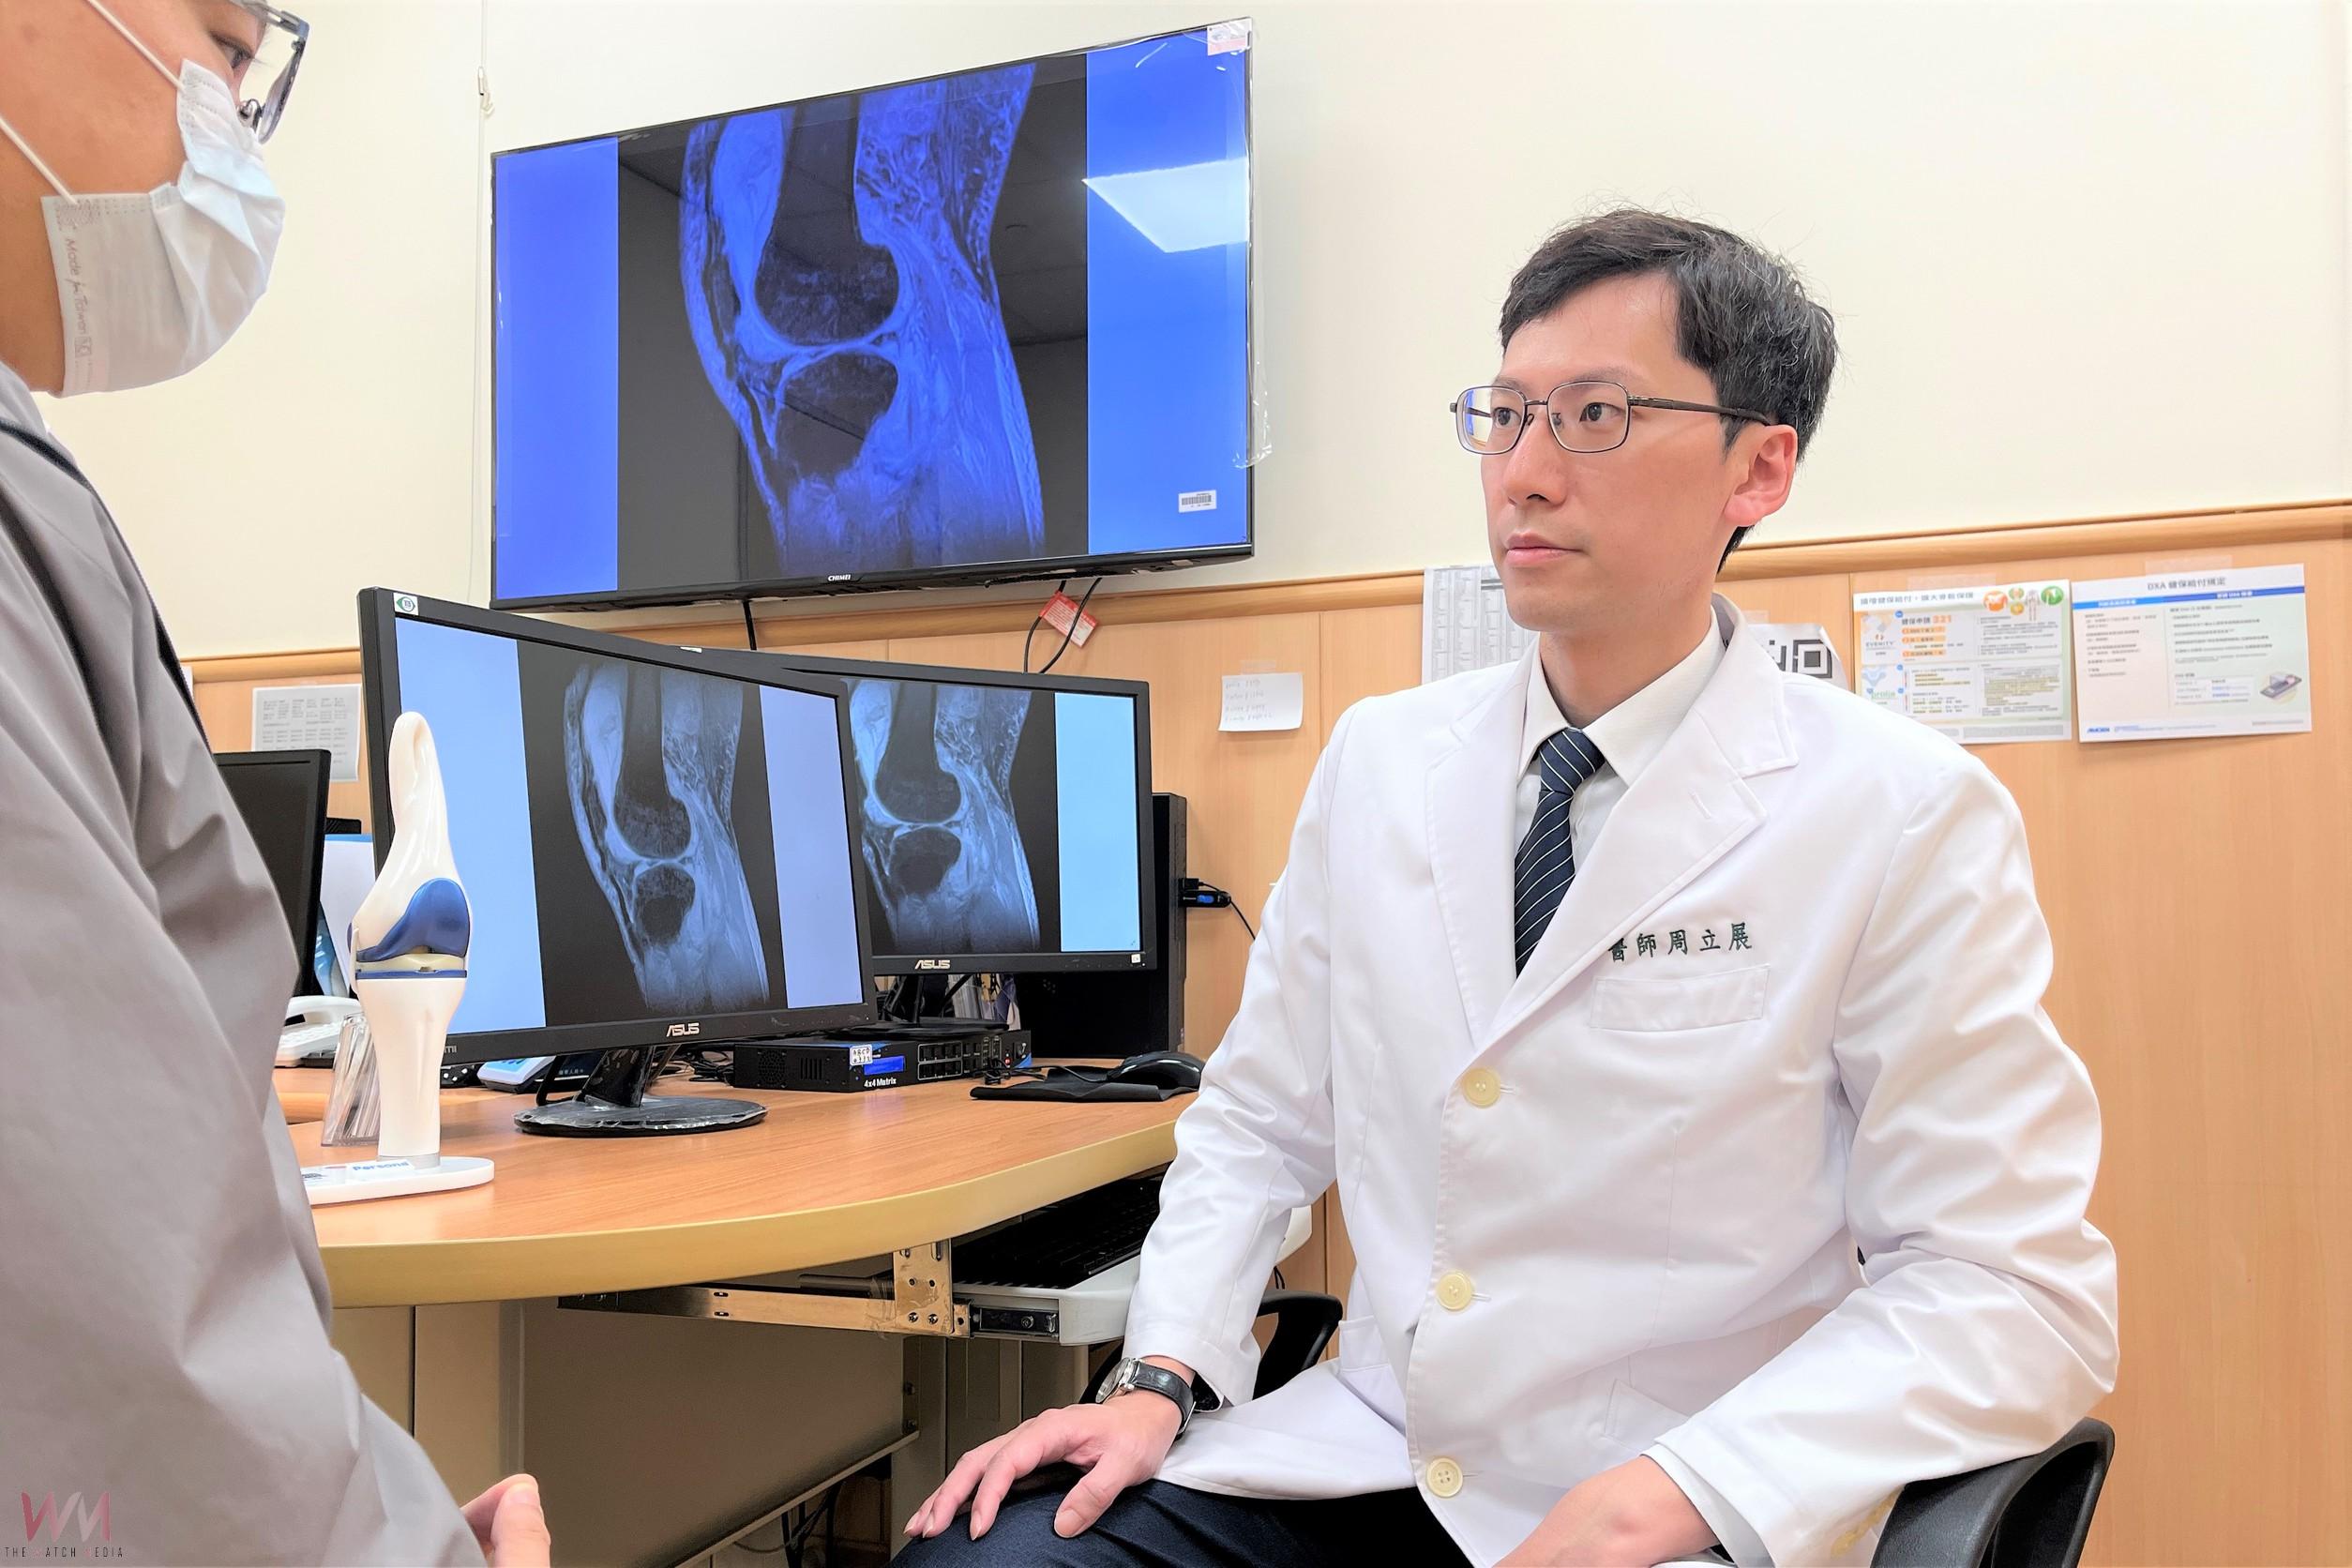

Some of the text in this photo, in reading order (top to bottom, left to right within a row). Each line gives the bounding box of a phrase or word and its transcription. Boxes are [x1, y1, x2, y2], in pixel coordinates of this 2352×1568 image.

[914, 959, 951, 970] ASUS
[666, 1022, 700, 1037] ASUS
[864, 1077, 897, 1088] 4x4 Matrix
